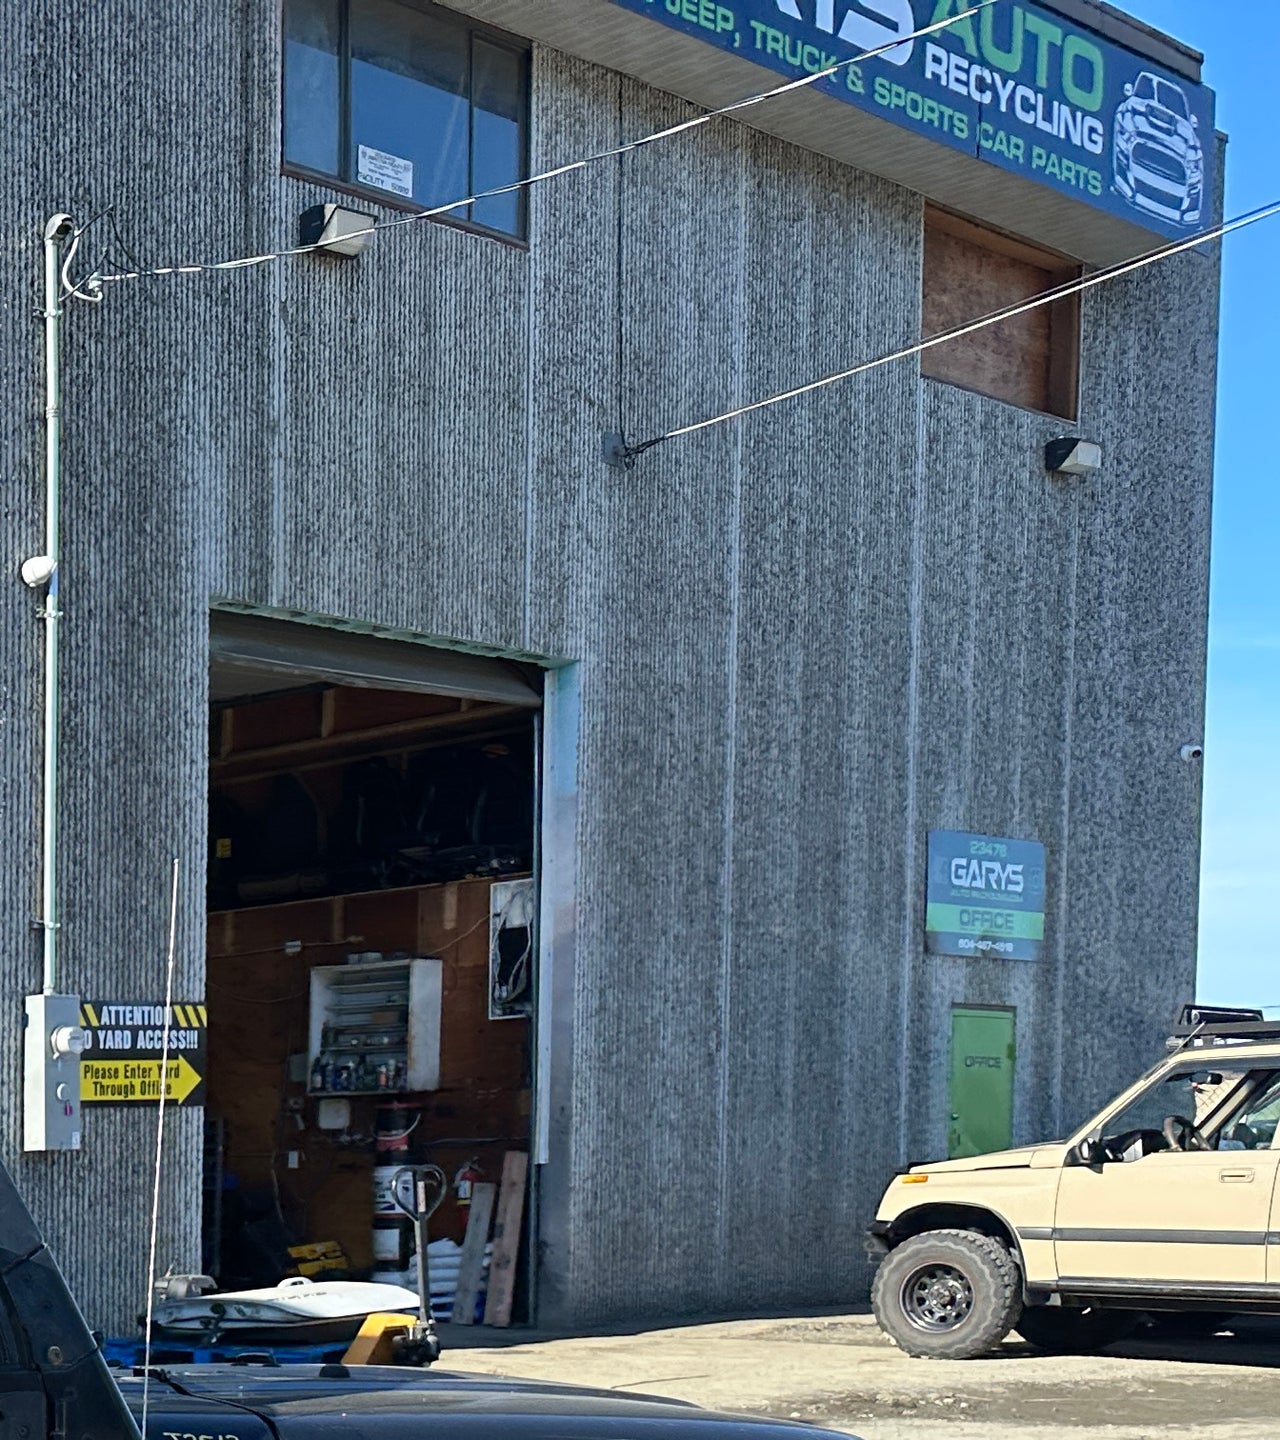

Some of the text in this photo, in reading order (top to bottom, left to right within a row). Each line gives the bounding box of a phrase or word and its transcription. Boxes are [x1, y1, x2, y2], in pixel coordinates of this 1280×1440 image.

[928, 0, 1104, 112] AUTO
[749, 20, 837, 82] TRUCK
[846, 65, 865, 94] &
[873, 77, 969, 140] SPORTS
[976, 121, 1024, 164] CAR
[1031, 144, 1103, 196] PARTS
[925, 42, 1104, 155] RECYCLING
[951, 857, 1024, 893] GARYS
[959, 908, 1015, 931] OFFICE
[100, 1004, 172, 1026] ATTENTION
[97, 1030, 132, 1050] YARD
[84, 1064, 119, 1080] Please
[124, 1064, 152, 1080] Enter
[964, 1055, 1001, 1069] OFFICE
[93, 1080, 172, 1099] Through Offie
